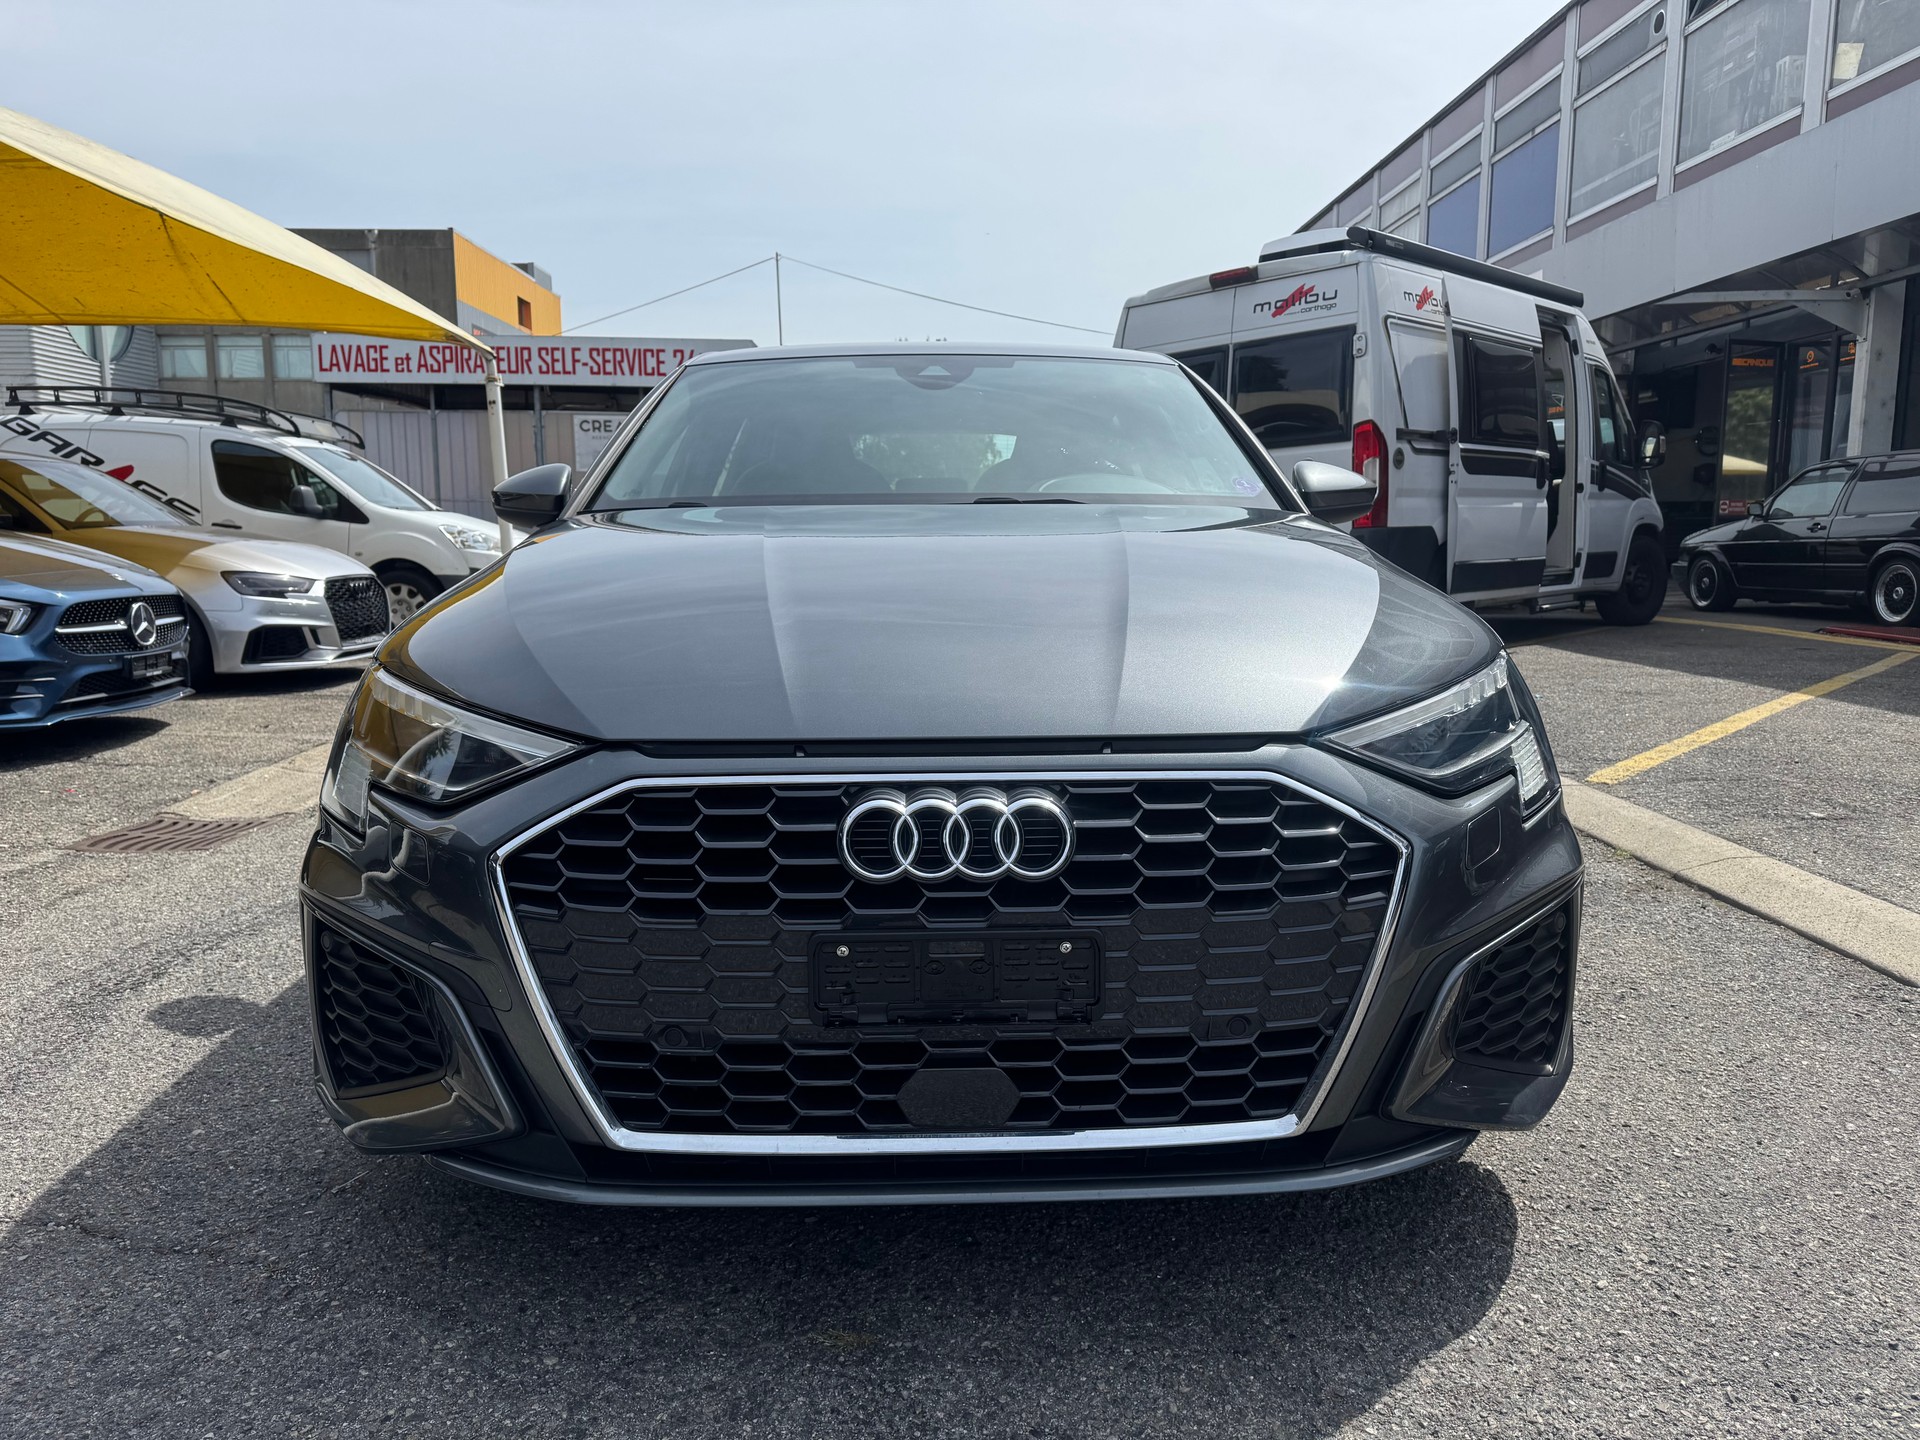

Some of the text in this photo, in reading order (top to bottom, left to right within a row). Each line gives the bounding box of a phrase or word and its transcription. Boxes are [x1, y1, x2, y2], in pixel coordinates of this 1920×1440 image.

[1253, 289, 1338, 314] malibu
[1300, 302, 1337, 314] carthago
[318, 344, 390, 373] LAVAGE
[394, 353, 413, 373] et
[416, 345, 533, 375] ASPIRAEUR
[537, 347, 668, 377] SELF-SERVICE
